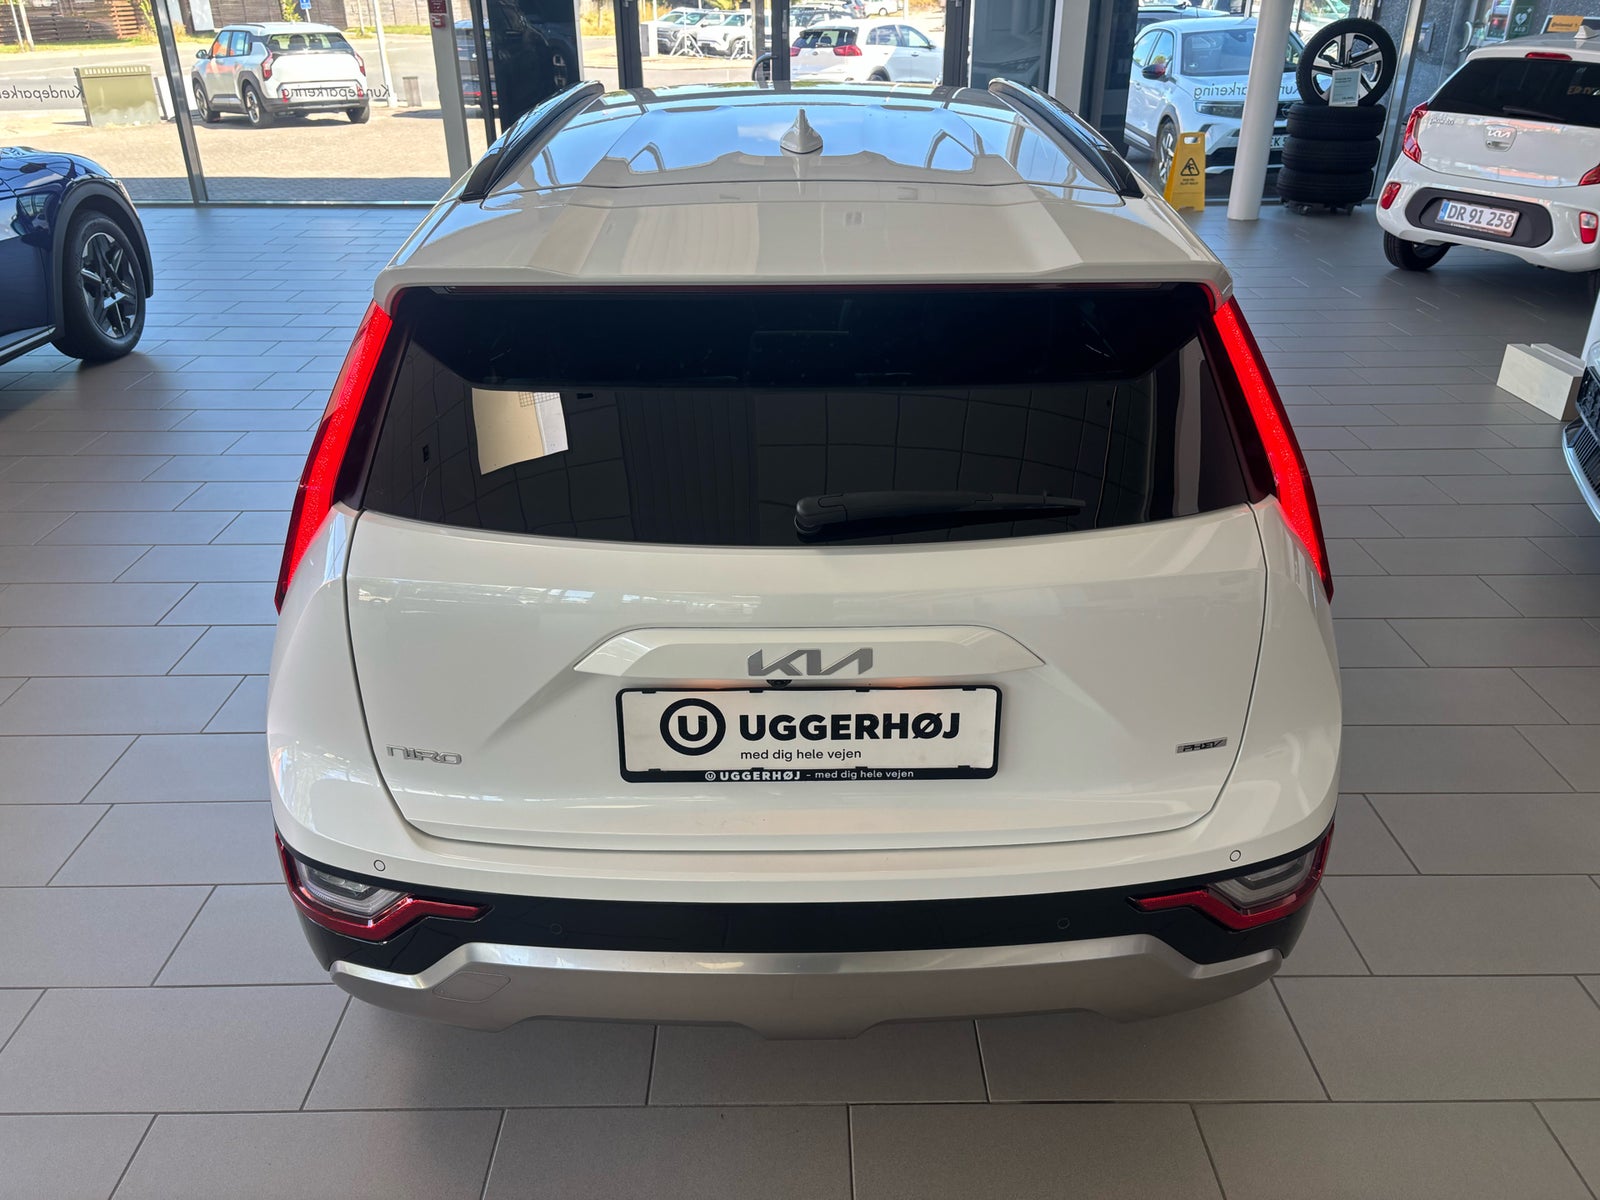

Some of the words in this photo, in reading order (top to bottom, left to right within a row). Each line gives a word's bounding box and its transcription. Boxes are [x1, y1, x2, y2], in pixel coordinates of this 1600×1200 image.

[1447, 204, 1467, 221] DR
[1468, 208, 1484, 225] 91
[1486, 211, 1515, 230] 258
[747, 648, 873, 676] KIA
[739, 712, 960, 742] UGGERHØJ
[740, 749, 769, 760] med
[772, 749, 793, 762] dig
[796, 749, 824, 760] hele
[828, 748, 862, 761] vejen
[720, 770, 800, 780] UGGERHØJ
[815, 770, 838, 779] med
[840, 770, 857, 780] dig
[860, 770, 883, 779] hele
[885, 769, 914, 780] vejen
